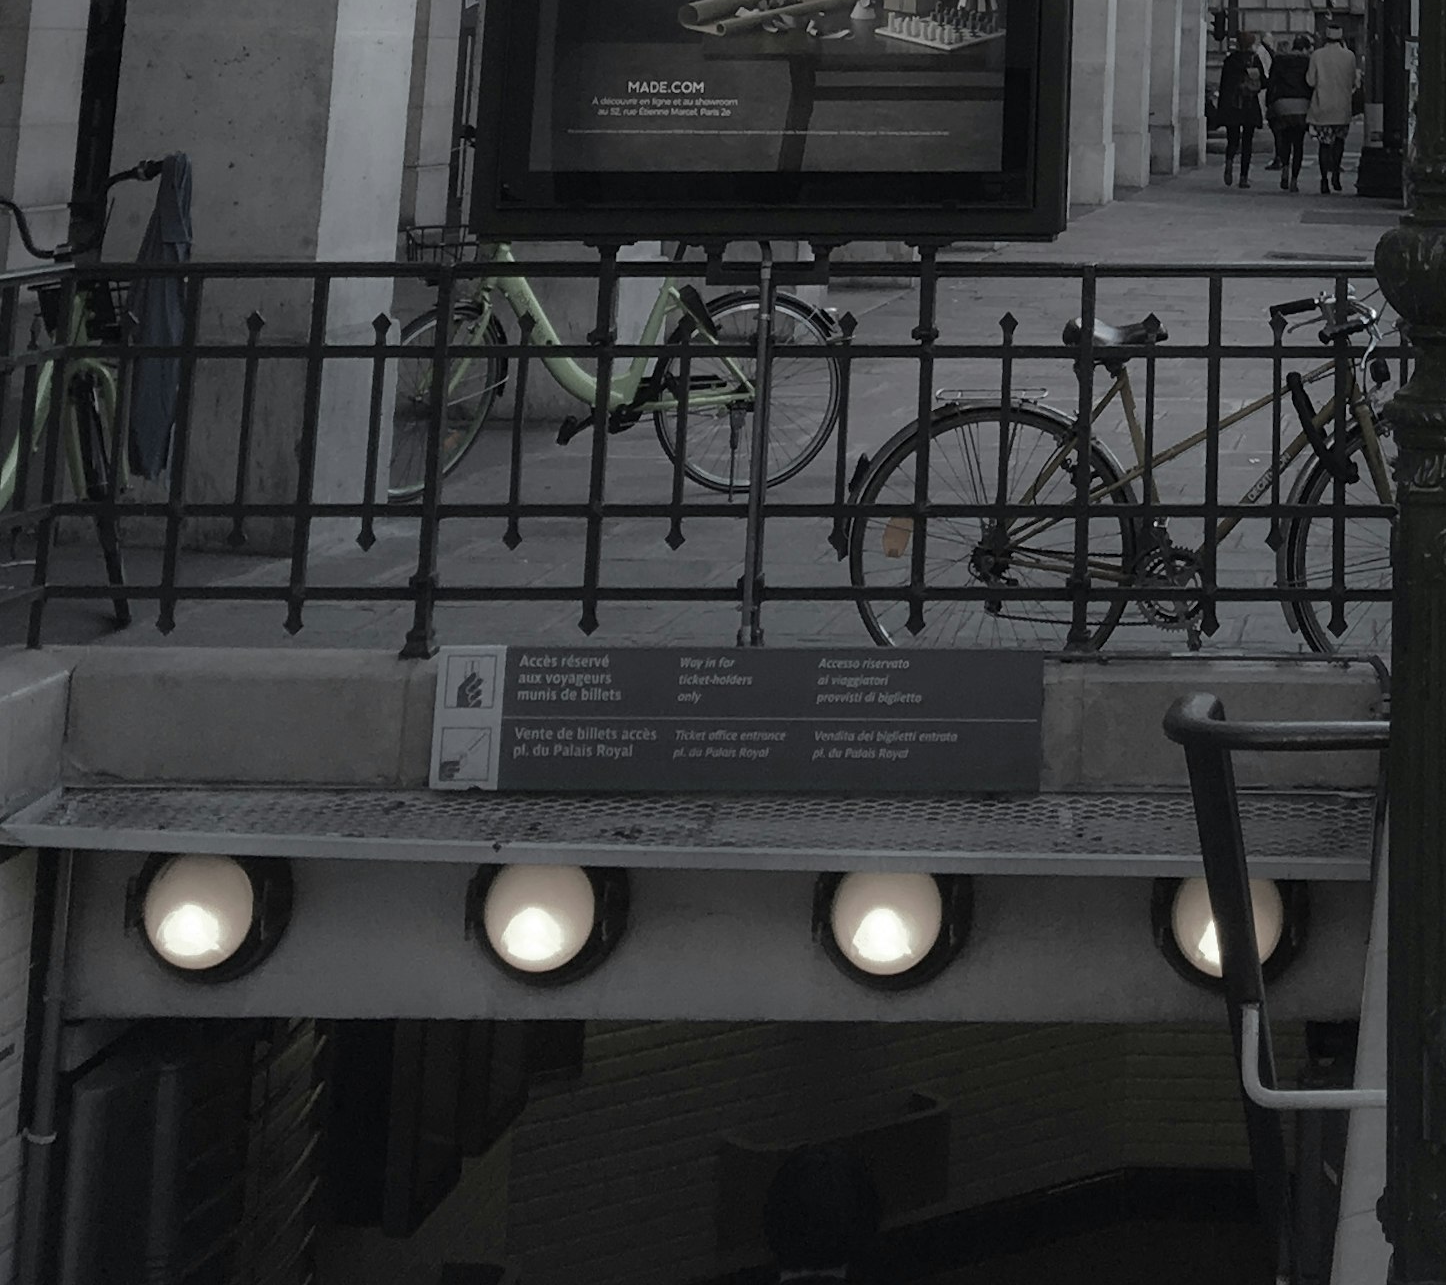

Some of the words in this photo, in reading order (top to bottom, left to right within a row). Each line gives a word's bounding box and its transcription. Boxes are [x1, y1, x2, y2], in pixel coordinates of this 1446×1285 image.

[628, 82, 705, 94] MADE.COM
[518, 653, 558, 668] Accès
[560, 653, 611, 668] réservé
[679, 657, 704, 670] Way
[705, 657, 716, 669] in
[718, 656, 736, 669] for
[817, 658, 861, 670] Accesso
[862, 658, 910, 670] riservato
[518, 674, 542, 685] aux
[545, 673, 613, 687] voyageurs
[678, 674, 753, 687] ticket-holders
[817, 675, 830, 687] ai
[830, 675, 890, 689] viaggiatori
[516, 688, 558, 701] munis
[560, 688, 577, 701] de
[580, 687, 623, 702] billets
[676, 691, 702, 704] only
[815, 692, 863, 705] provvisti
[864, 692, 876, 704] di
[878, 692, 923, 706] biglietto
[514, 727, 554, 741] Vente
[556, 727, 574, 741] de
[576, 726, 618, 741] billets
[621, 727, 658, 741] accès
[674, 729, 706, 742] Ticket
[708, 729, 738, 742] office
[740, 730, 787, 742] entrance
[814, 730, 856, 742] Vendita
[857, 730, 874, 742] dei
[876, 730, 917, 744] biglietti
[918, 731, 958, 743] entrata
[512, 744, 529, 759] pl.
[532, 744, 550, 757] du
[552, 744, 594, 758] Palais
[596, 744, 634, 760] Royal
[672, 746, 687, 760] pl.
[688, 746, 703, 758] du
[705, 746, 737, 758] Palais
[738, 746, 770, 760] Royal
[811, 747, 826, 761] pl.
[828, 747, 843, 759] du
[844, 747, 876, 759] Palais
[878, 747, 909, 761] Royal
